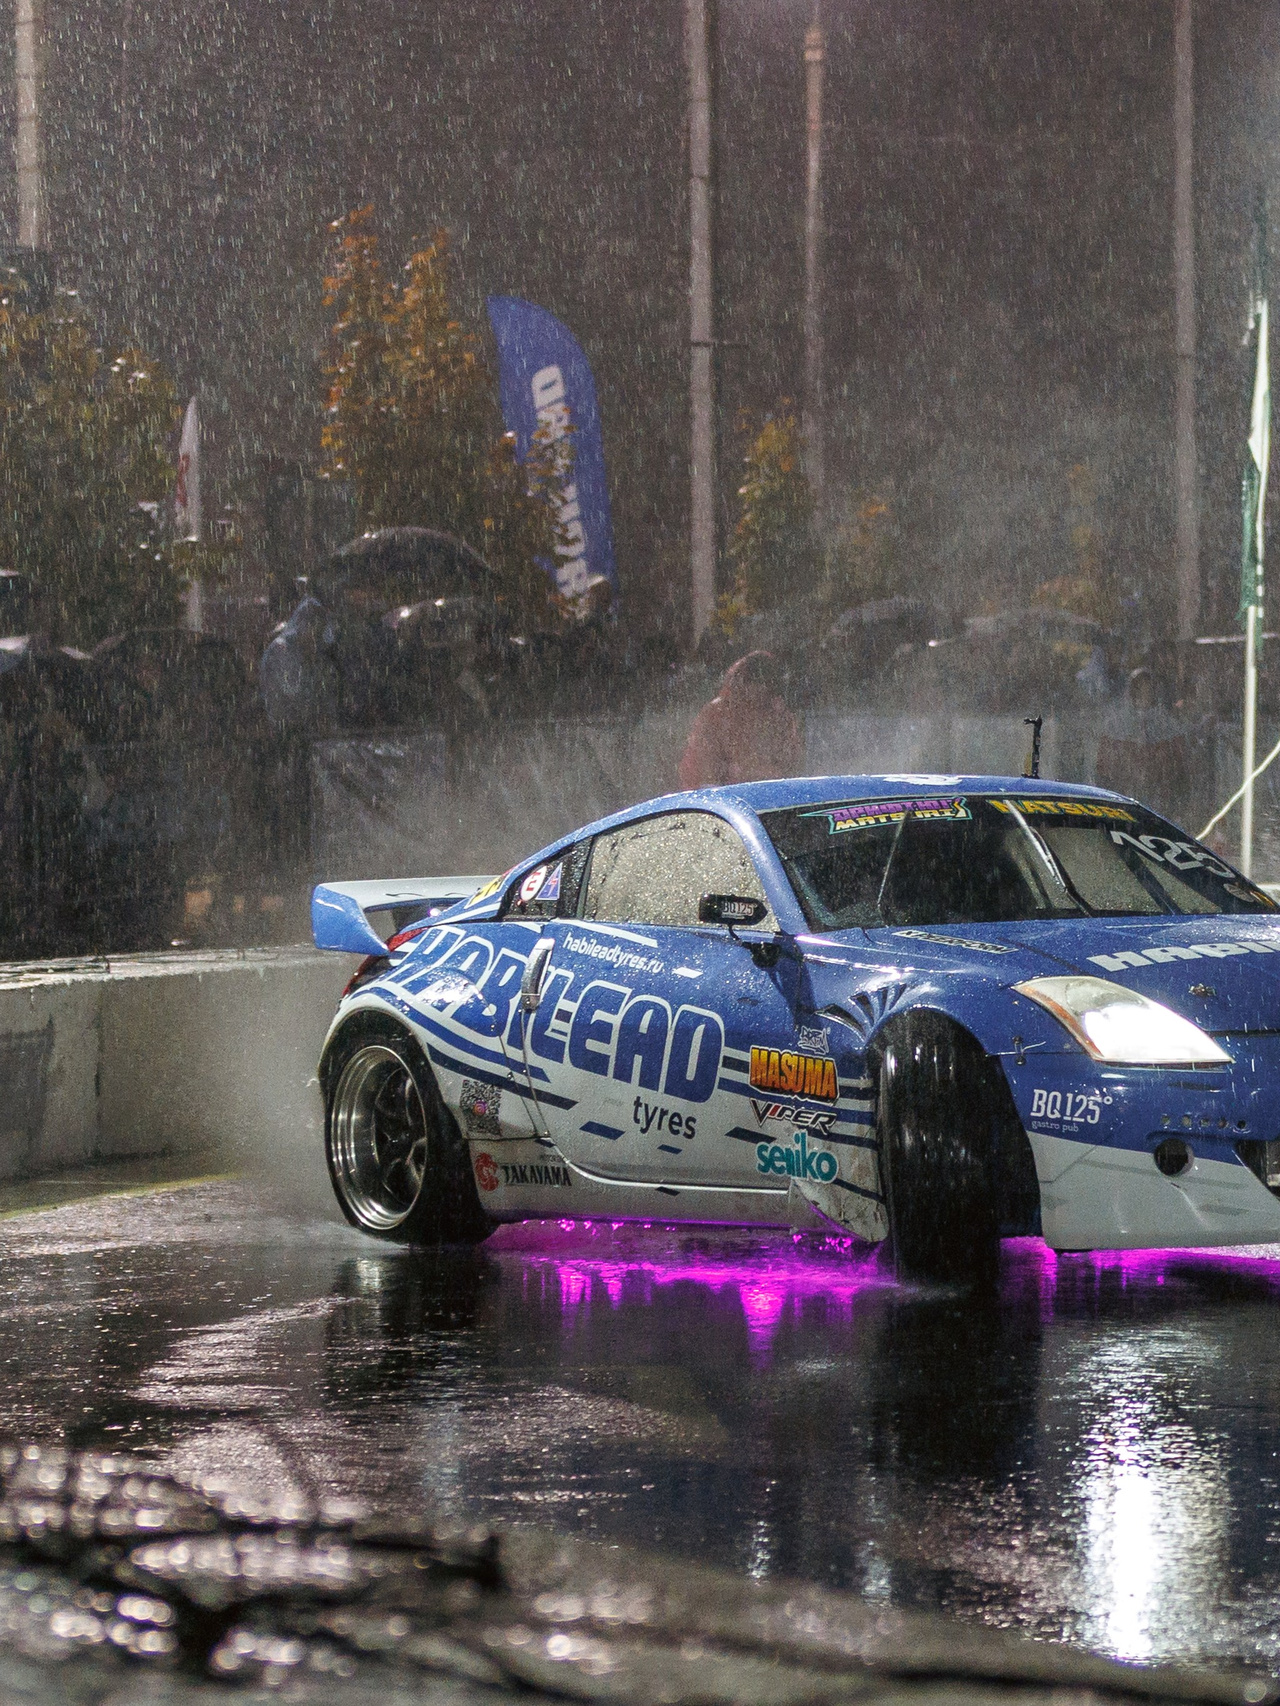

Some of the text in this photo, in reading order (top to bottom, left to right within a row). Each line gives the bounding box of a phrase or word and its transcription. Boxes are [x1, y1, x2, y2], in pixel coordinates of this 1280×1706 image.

[1110, 830, 1236, 878] 125
[563, 931, 664, 974] habileadtyres.ru
[750, 1046, 839, 1101] MASUMA
[633, 1096, 697, 1140] tyres
[750, 1098, 838, 1136] VIPER
[1031, 1120, 1079, 1132] gastro pub
[502, 1164, 573, 1187] TAKAYAMA
[757, 1131, 839, 1183] seniko
